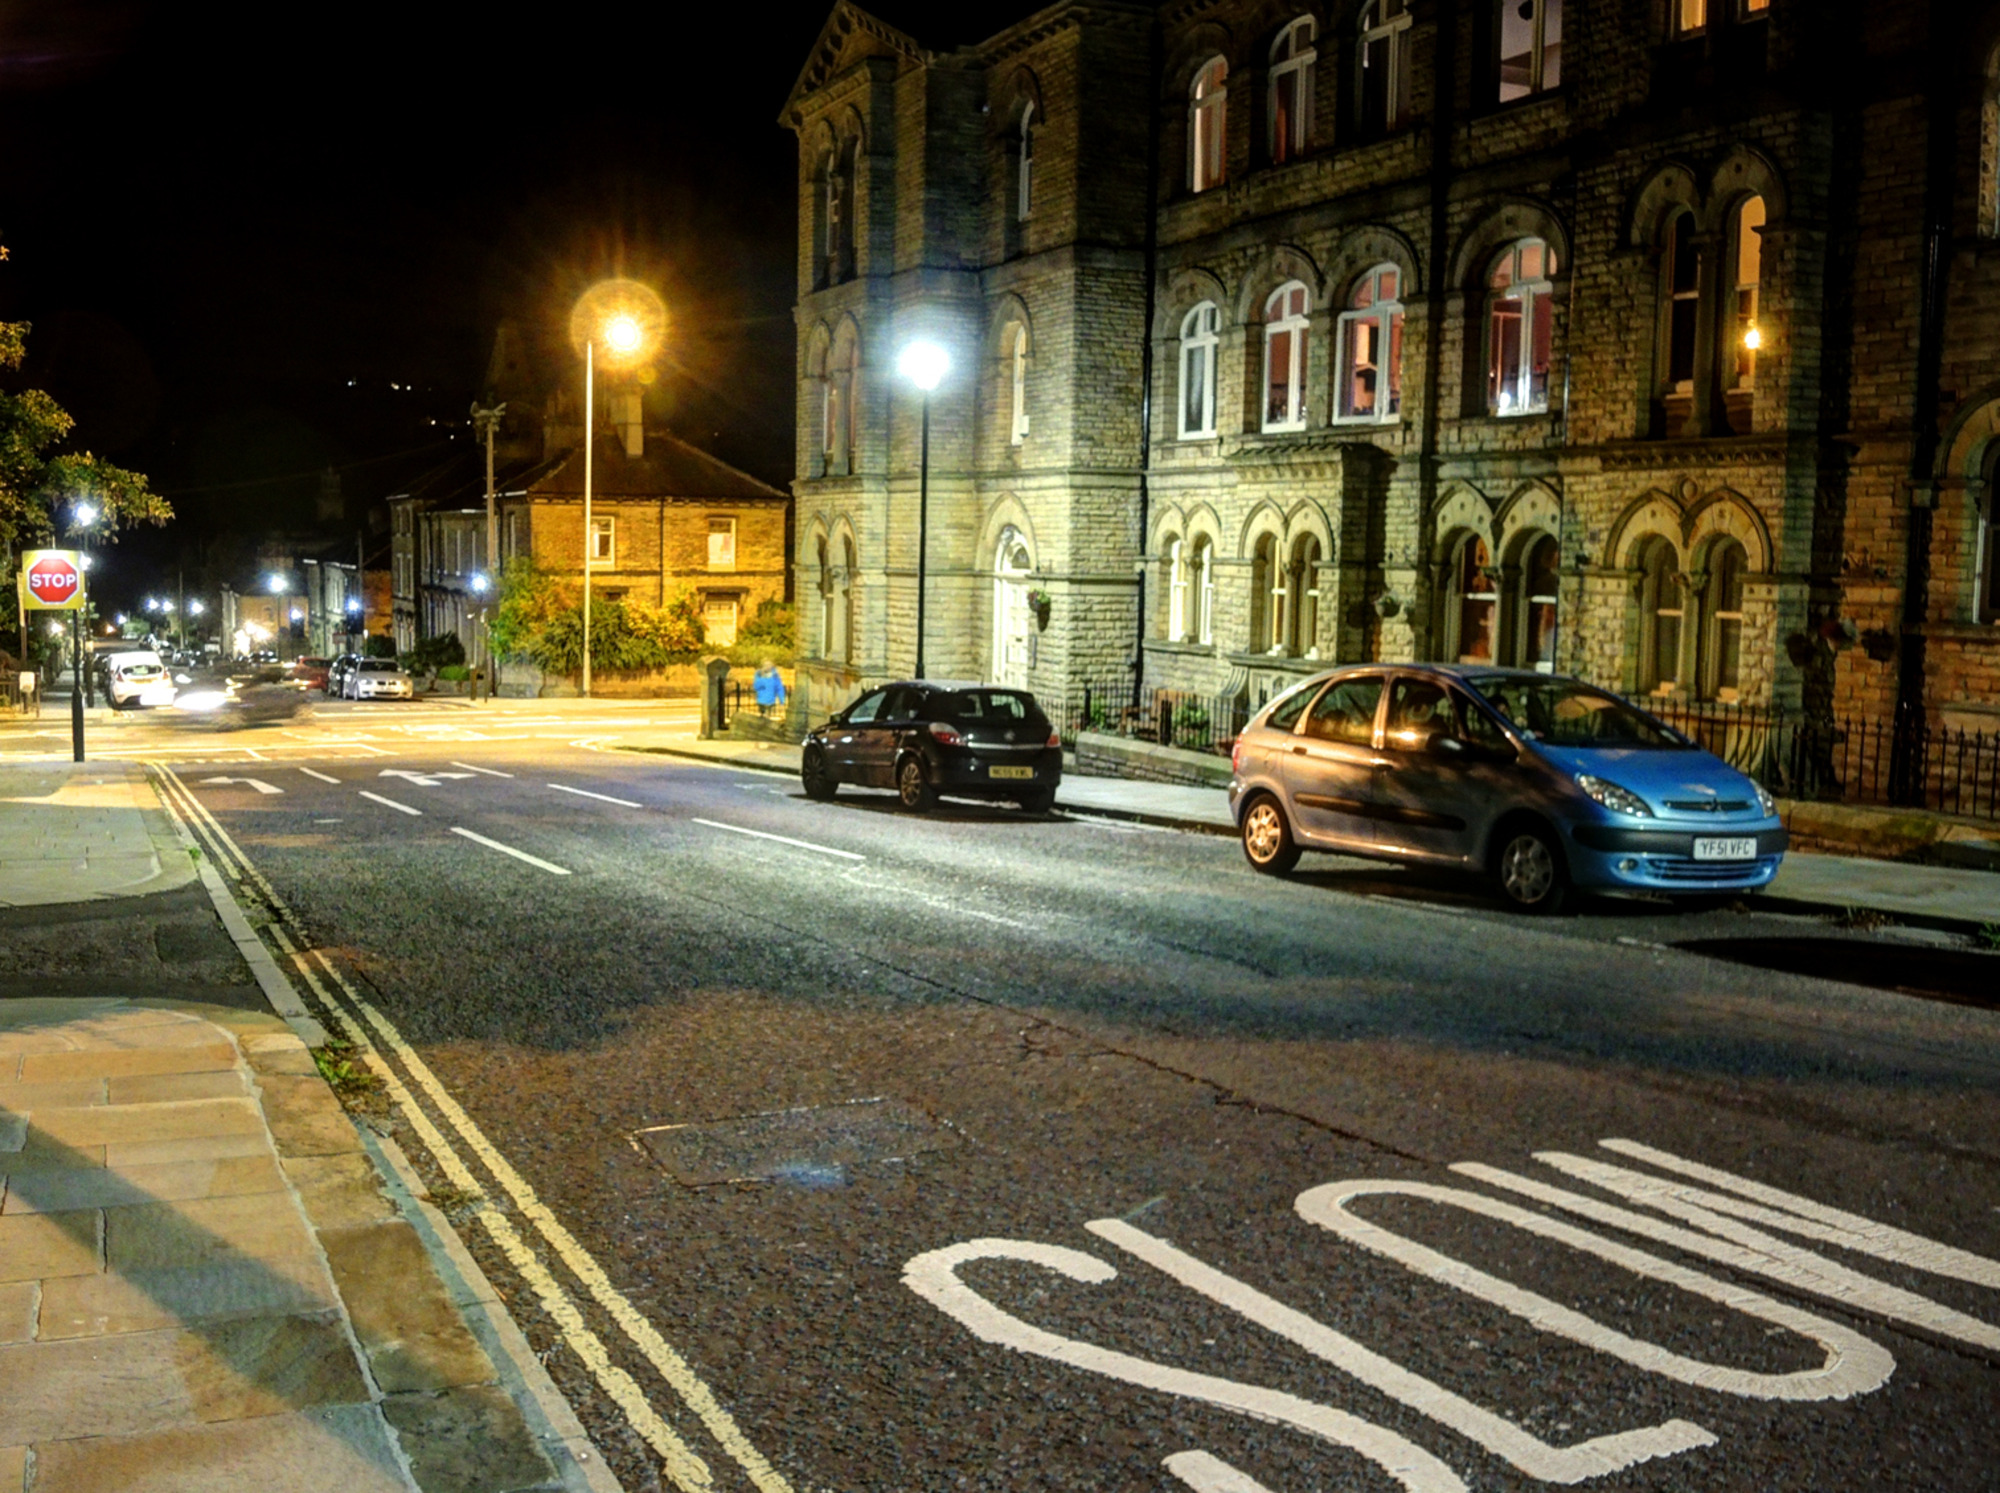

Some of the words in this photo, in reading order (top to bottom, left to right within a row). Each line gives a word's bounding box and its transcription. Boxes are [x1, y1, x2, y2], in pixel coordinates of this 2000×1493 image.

[31, 573, 76, 588] STOP
[1700, 840, 1728, 855] YF51
[1730, 840, 1751, 855] VFC
[901, 1137, 2000, 1493] SLOW
